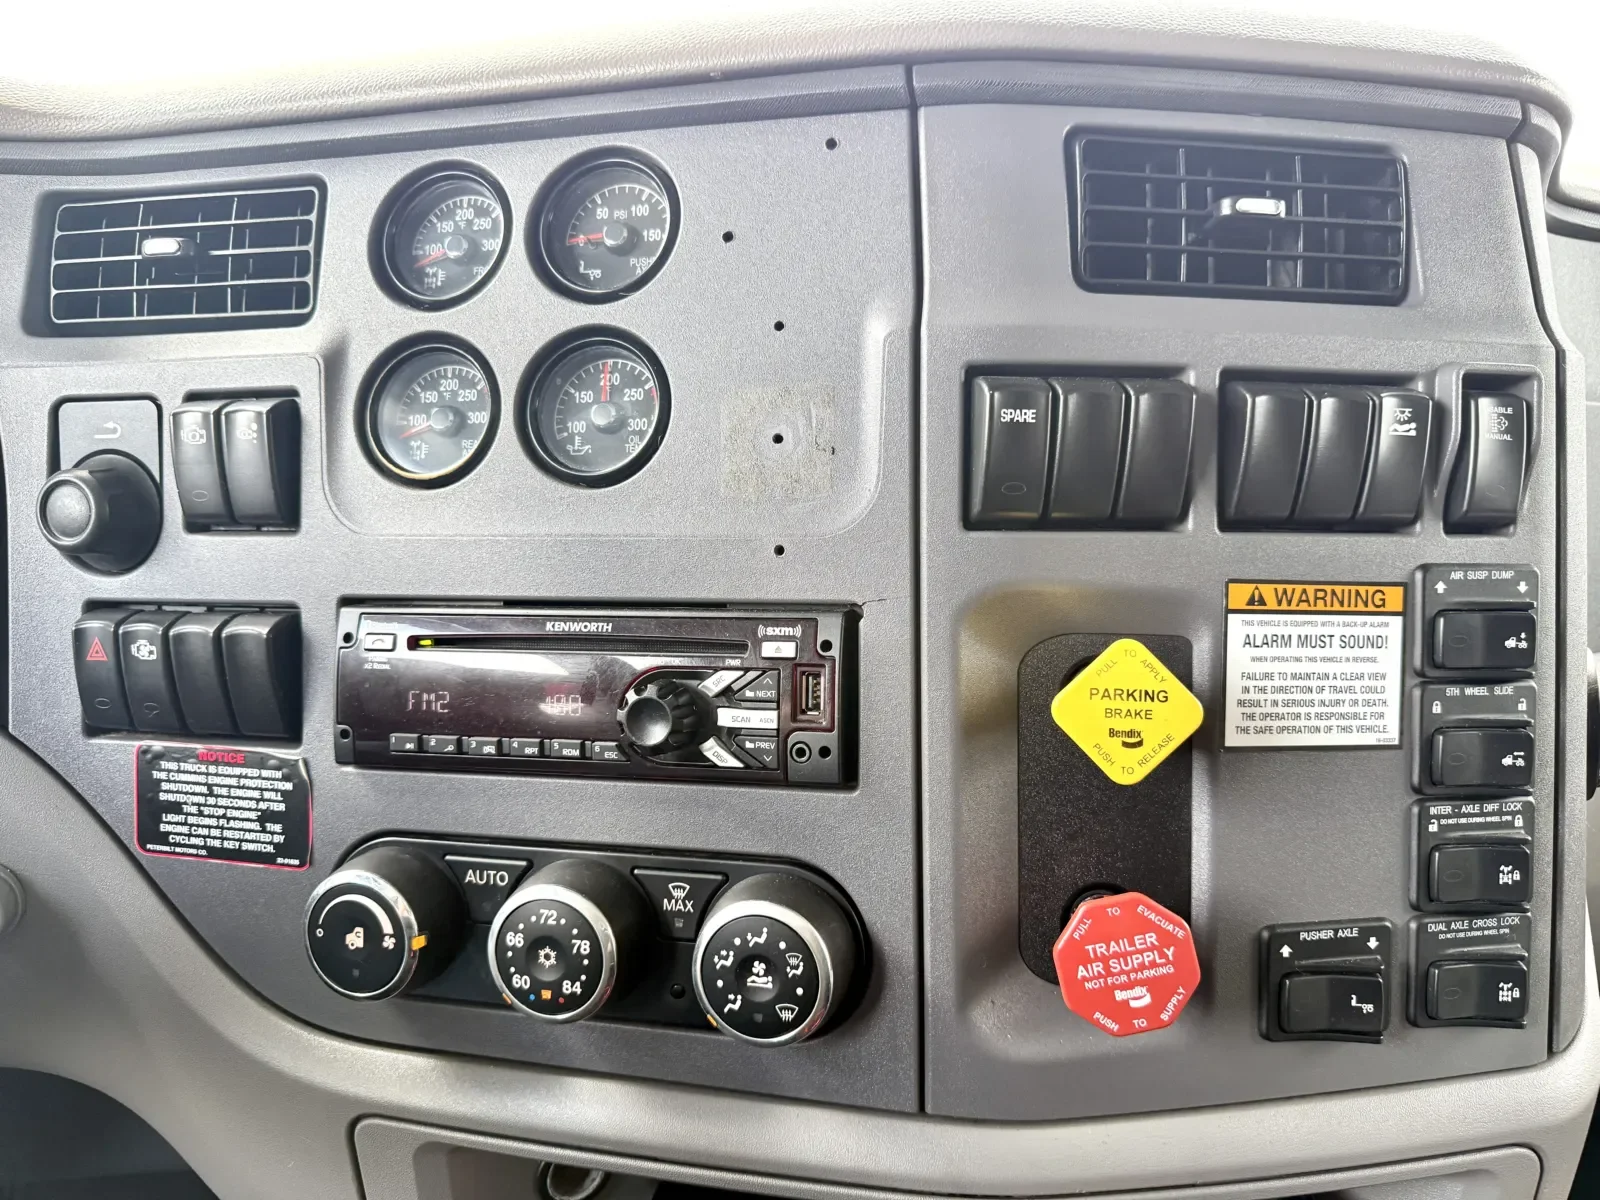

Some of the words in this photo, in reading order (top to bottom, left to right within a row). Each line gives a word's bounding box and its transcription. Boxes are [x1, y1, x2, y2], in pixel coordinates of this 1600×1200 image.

[455, 208, 474, 221] 200
[596, 207, 609, 219] 50
[614, 210, 628, 219] PSI
[631, 204, 649, 216] 100
[436, 221, 454, 233] 150
[472, 218, 492, 231] 250
[643, 229, 661, 241] 150
[425, 243, 443, 255] 100
[481, 239, 500, 251] 300
[440, 379, 459, 391] 200
[420, 391, 438, 403] 150
[458, 389, 477, 402] 250
[574, 390, 593, 403] 150
[624, 388, 644, 401] 250
[409, 414, 427, 426] 100
[467, 412, 487, 424] 300
[1000, 408, 1037, 423] SPARE
[567, 421, 586, 433] 100
[627, 418, 648, 431] 300
[1450, 571, 1464, 580] AIR
[1467, 571, 1489, 580] SUSP
[1492, 571, 1515, 580] DUMP
[1273, 587, 1386, 609] WARNING
[545, 621, 612, 632] KENWORTH
[1242, 634, 1292, 648] ALARM
[1297, 634, 1335, 649] MUST
[1339, 634, 1388, 649] SOUND!
[1095, 659, 1118, 677] PULL
[1124, 649, 1137, 658] TO
[1140, 658, 1168, 684] APPLY
[1241, 672, 1275, 681] FAILURE
[1277, 672, 1288, 681] TO
[1290, 672, 1330, 681] MAINTAIN
[1340, 672, 1365, 681] CLEAR
[1367, 672, 1387, 681] VIEW
[756, 690, 776, 698] NEXT
[1089, 687, 1169, 703] PARKING
[1241, 685, 1250, 694] IN
[1252, 685, 1268, 694] THE
[1270, 685, 1313, 694] DIRECTION
[1315, 685, 1326, 694] OF
[1328, 685, 1358, 694] TRAVEL
[1360, 685, 1386, 694] COULD
[1446, 687, 1460, 697] 5TH
[1464, 687, 1489, 696] WHEEL
[1494, 686, 1514, 695] SLIDE
[406, 690, 450, 713] FM2
[1236, 699, 1268, 708] RESULT
[1270, 699, 1279, 708] IN
[1281, 699, 1316, 708] SERIOUS
[1317, 698, 1346, 708] INJURY
[1348, 698, 1359, 707] OR
[1361, 698, 1389, 707] DEATH.
[731, 715, 751, 723] SCAN
[1104, 707, 1153, 720] BRAKE
[1240, 712, 1257, 721] THE
[1258, 712, 1302, 721] OPERATOR
[1304, 712, 1312, 720] IS
[1314, 711, 1368, 720] RESPONSIBLE
[1370, 711, 1385, 720] FOR
[1108, 727, 1142, 739] Bendix
[1235, 725, 1251, 734] THE
[1253, 725, 1274, 734] SAFE
[1276, 725, 1321, 734] OPERATION
[1323, 725, 1334, 734] OF
[1336, 725, 1353, 733] THIS
[1355, 724, 1389, 733] VEHICLE.
[755, 741, 776, 749] PREV
[198, 751, 246, 764] NOTICE
[562, 748, 580, 756] RDM
[712, 750, 728, 764] DISP
[1093, 743, 1116, 767] PUSH
[1121, 766, 1135, 775] TO
[1137, 733, 1175, 767] RELEASE
[160, 761, 179, 770] THIS
[179, 763, 207, 773] TRUCK
[208, 765, 217, 773] IS
[218, 766, 260, 777] EQUIPPED
[260, 769, 282, 779] WITH
[152, 771, 169, 780] THE
[169, 772, 207, 783] CUMMINS
[207, 775, 239, 786] ENGINE
[240, 778, 293, 791] PROTECTION
[161, 782, 209, 794] SHUTDOWN.
[212, 786, 229, 796] THE
[230, 788, 262, 799] ENGINE
[262, 791, 283, 801] WILL
[159, 792, 206, 804] SHUTDOWN
[206, 796, 216, 805] 30
[217, 797, 257, 809] SECONDS
[258, 801, 286, 811] AFTER
[182, 805, 199, 813] THE
[1429, 806, 1452, 815] INTER
[1461, 804, 1480, 813] AXLE
[1483, 803, 1500, 812] DIFF
[1502, 802, 1523, 811] LOCK
[162, 813, 186, 823] LIGHT
[187, 816, 218, 826] BEGINS
[219, 819, 262, 830] FLASHING.
[265, 823, 283, 832] THE
[160, 824, 190, 834] ENGINE
[191, 826, 209, 836] CAN
[210, 828, 222, 837] BE
[223, 829, 272, 842] RESTARTED
[273, 834, 285, 843] BY
[169, 835, 204, 846] CYCLING
[206, 838, 222, 847] THE
[223, 840, 240, 849] KEY
[241, 842, 276, 853] SWITCH.
[464, 869, 509, 886] AUTO
[663, 899, 694, 913] MAX
[538, 909, 558, 925] 72
[1072, 918, 1092, 940] PULL
[1106, 907, 1121, 917] TO
[1136, 905, 1186, 939] EVACUATE
[1428, 923, 1447, 932] DUAL
[1450, 920, 1469, 930] AXLE
[1472, 918, 1497, 928] CROSS
[1501, 916, 1520, 925] LOCK
[506, 931, 525, 948] 66
[1300, 929, 1334, 940] PUSHER
[1337, 928, 1359, 938] AXLE
[571, 939, 591, 955] 78
[1085, 932, 1159, 959] TRAILER
[1077, 961, 1106, 979] AIR
[1109, 946, 1175, 972] SUPPLY
[511, 974, 531, 989] 60
[1084, 978, 1105, 990] NOT
[1107, 974, 1129, 986] FOR
[1130, 964, 1174, 983] PARKING
[561, 979, 582, 995] 84
[1114, 985, 1148, 1001] Bendix
[1093, 1011, 1120, 1032] PUSH
[1133, 1018, 1147, 1029] TO
[1160, 986, 1186, 1021] SUPPLY
